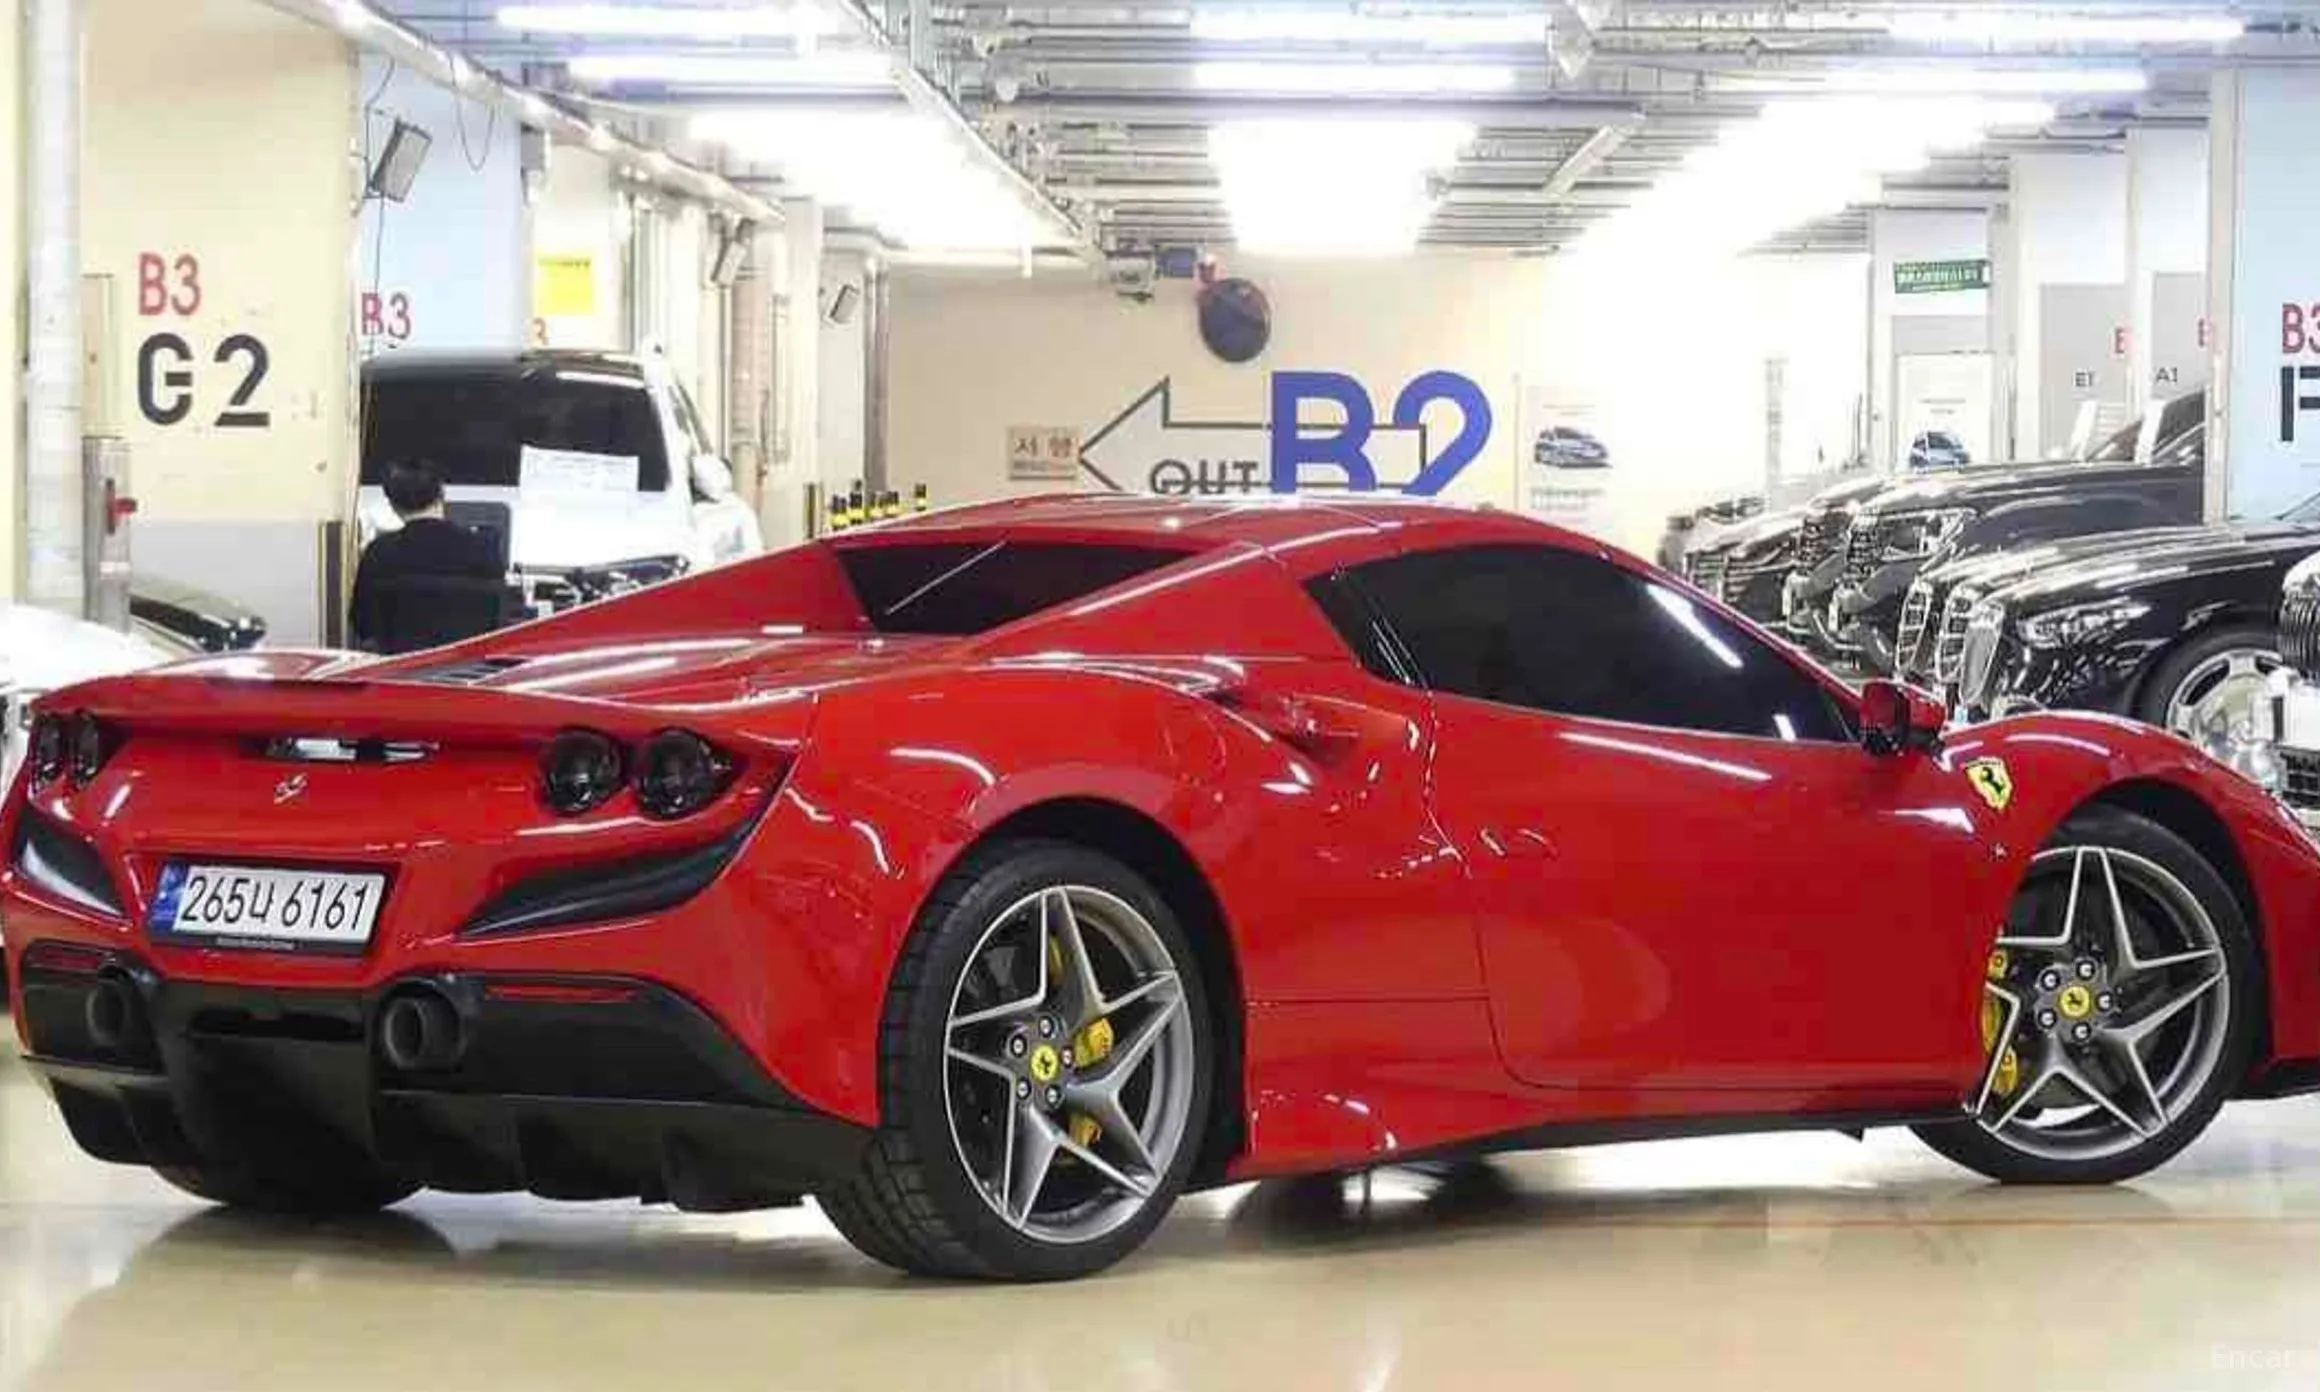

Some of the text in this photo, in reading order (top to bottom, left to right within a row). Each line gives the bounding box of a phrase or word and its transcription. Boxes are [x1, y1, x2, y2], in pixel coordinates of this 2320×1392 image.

[138, 253, 201, 316] B3
[361, 292, 412, 341] B3
[137, 332, 271, 427] G2
[1271, 370, 1492, 496] B2
[1150, 459, 1257, 495] OUT
[281, 879, 369, 931] 6161
